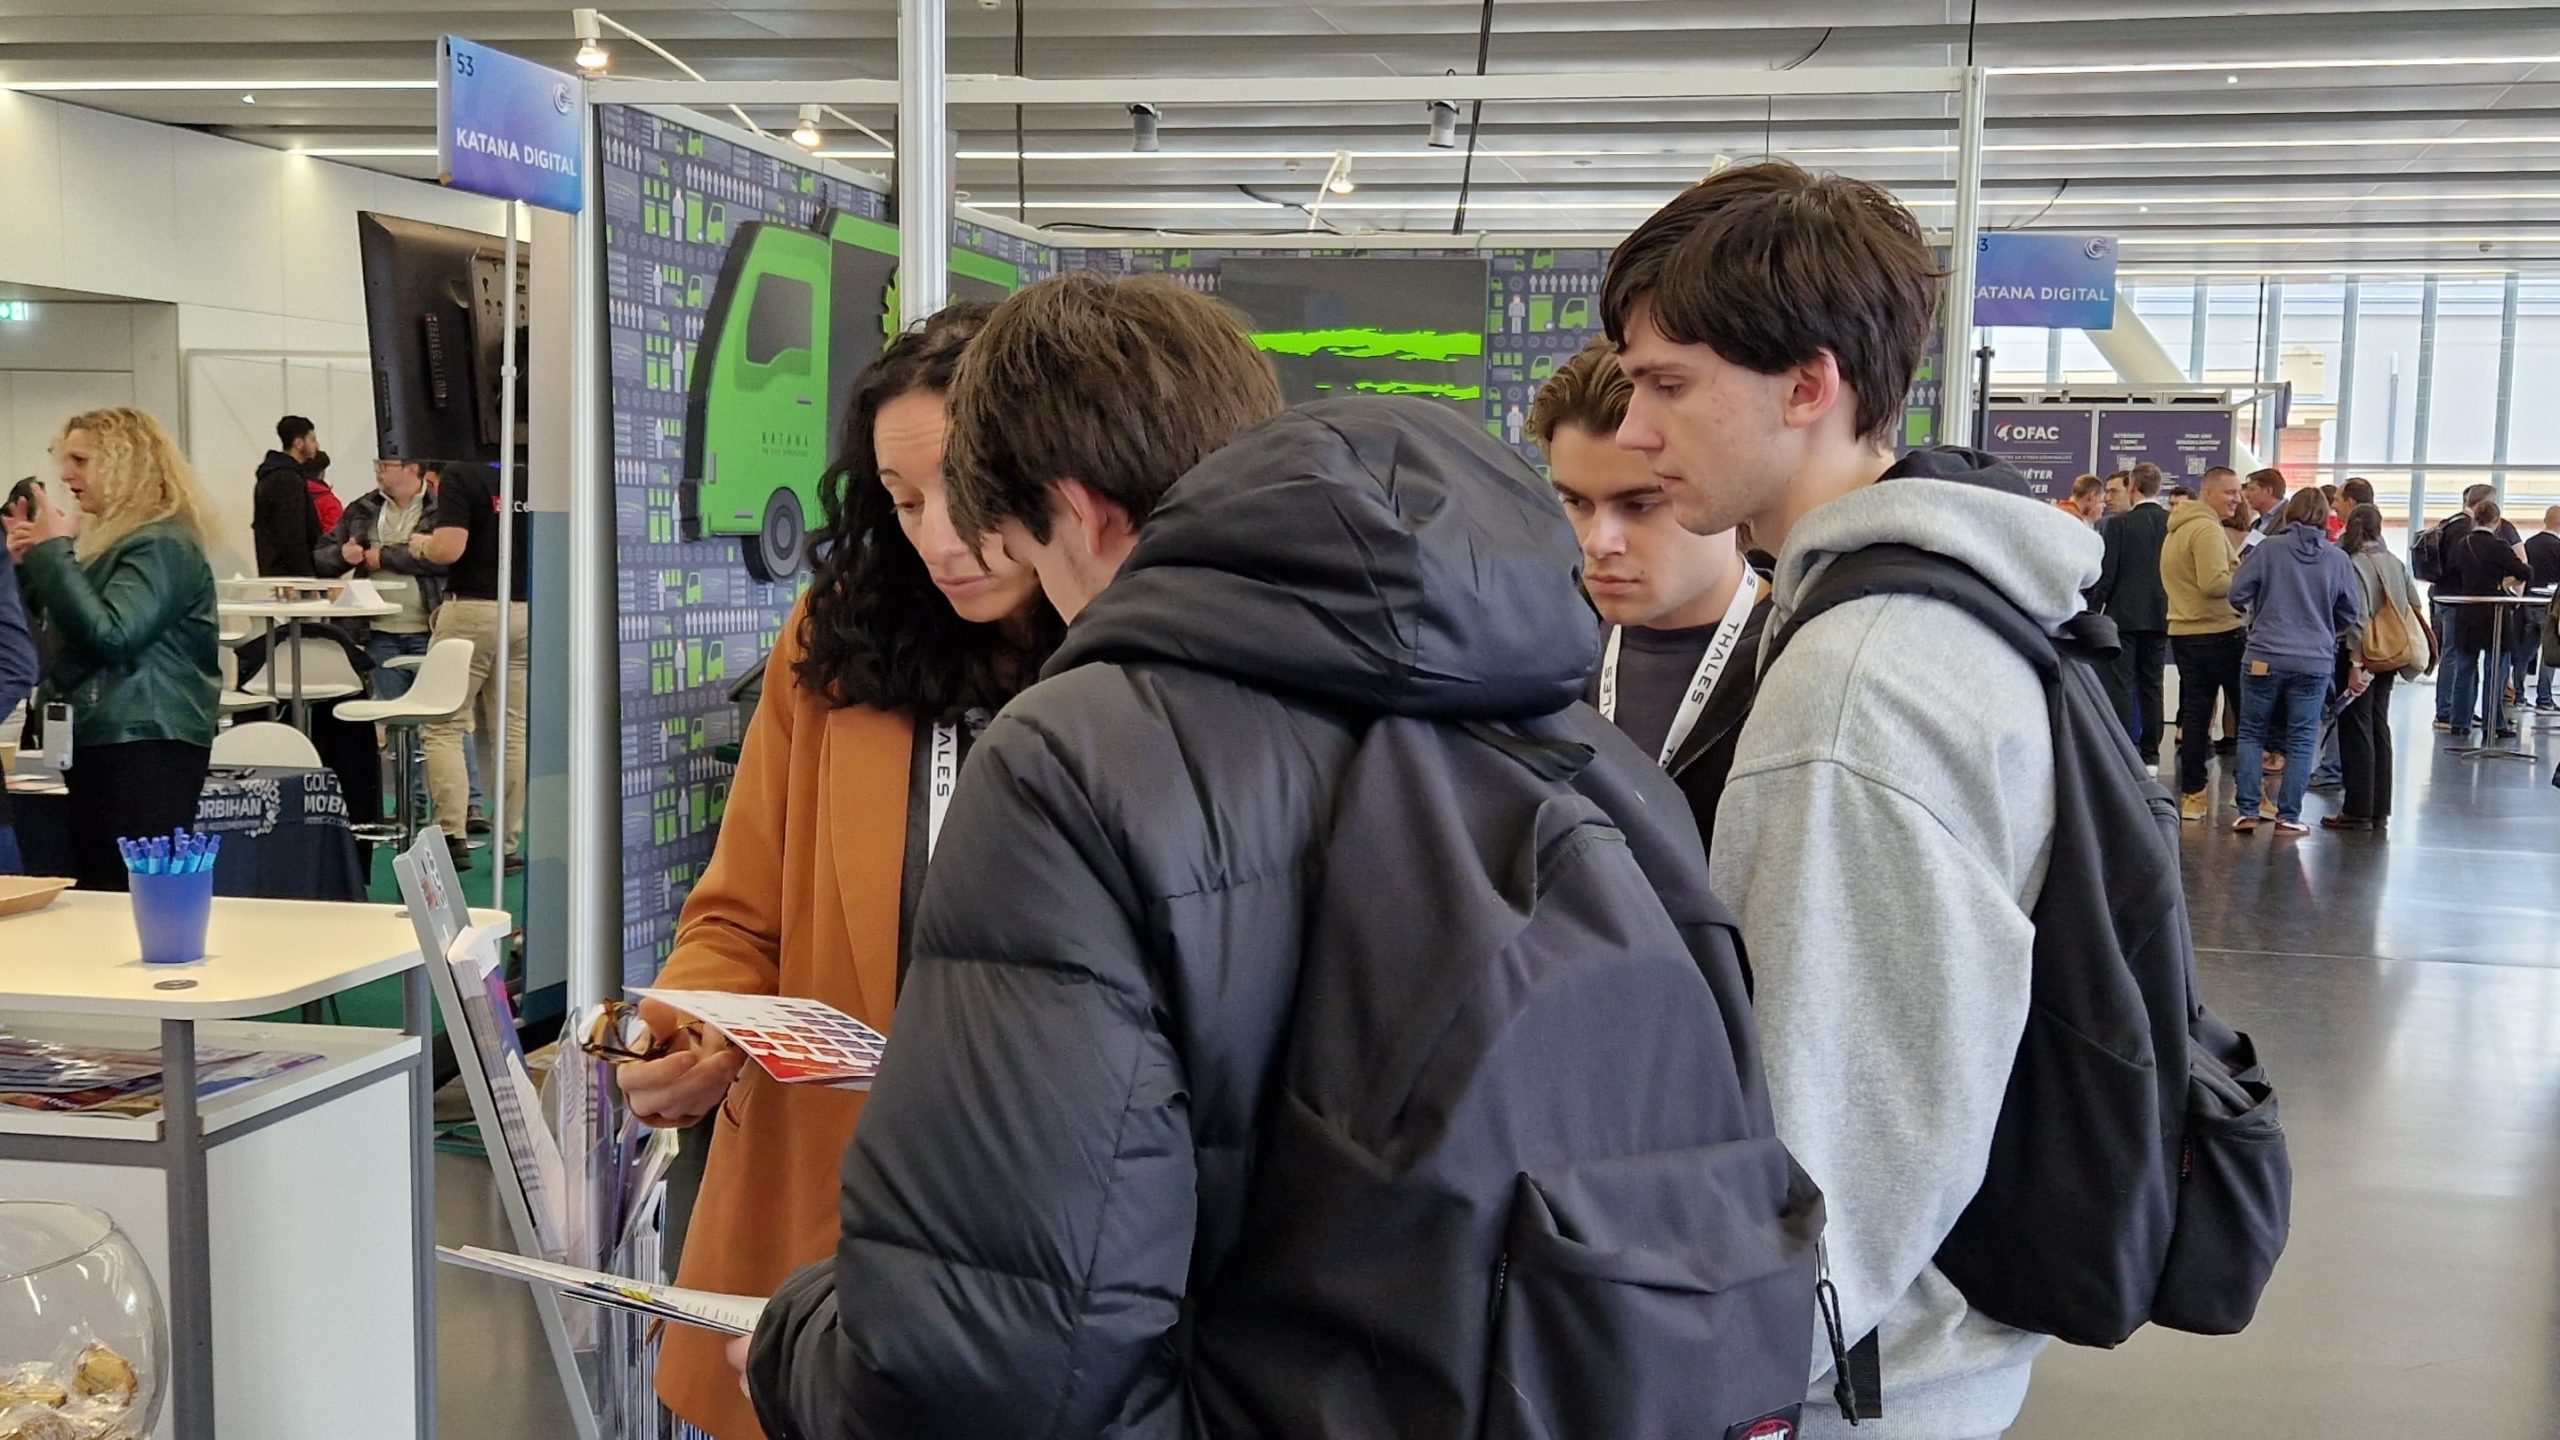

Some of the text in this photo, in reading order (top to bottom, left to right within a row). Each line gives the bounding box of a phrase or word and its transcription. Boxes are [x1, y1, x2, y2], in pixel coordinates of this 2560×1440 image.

[456, 52, 474, 77] 53
[456, 127, 578, 177] KATANA DIGITAL
[1977, 238, 1989, 252] 3
[1973, 286, 2110, 302] ATANA DIGITAL
[2012, 426, 2060, 441] OFAC
[1690, 621, 1741, 706] THALES
[936, 731, 952, 797] ALES
[194, 797, 262, 820] ORBIHAN
